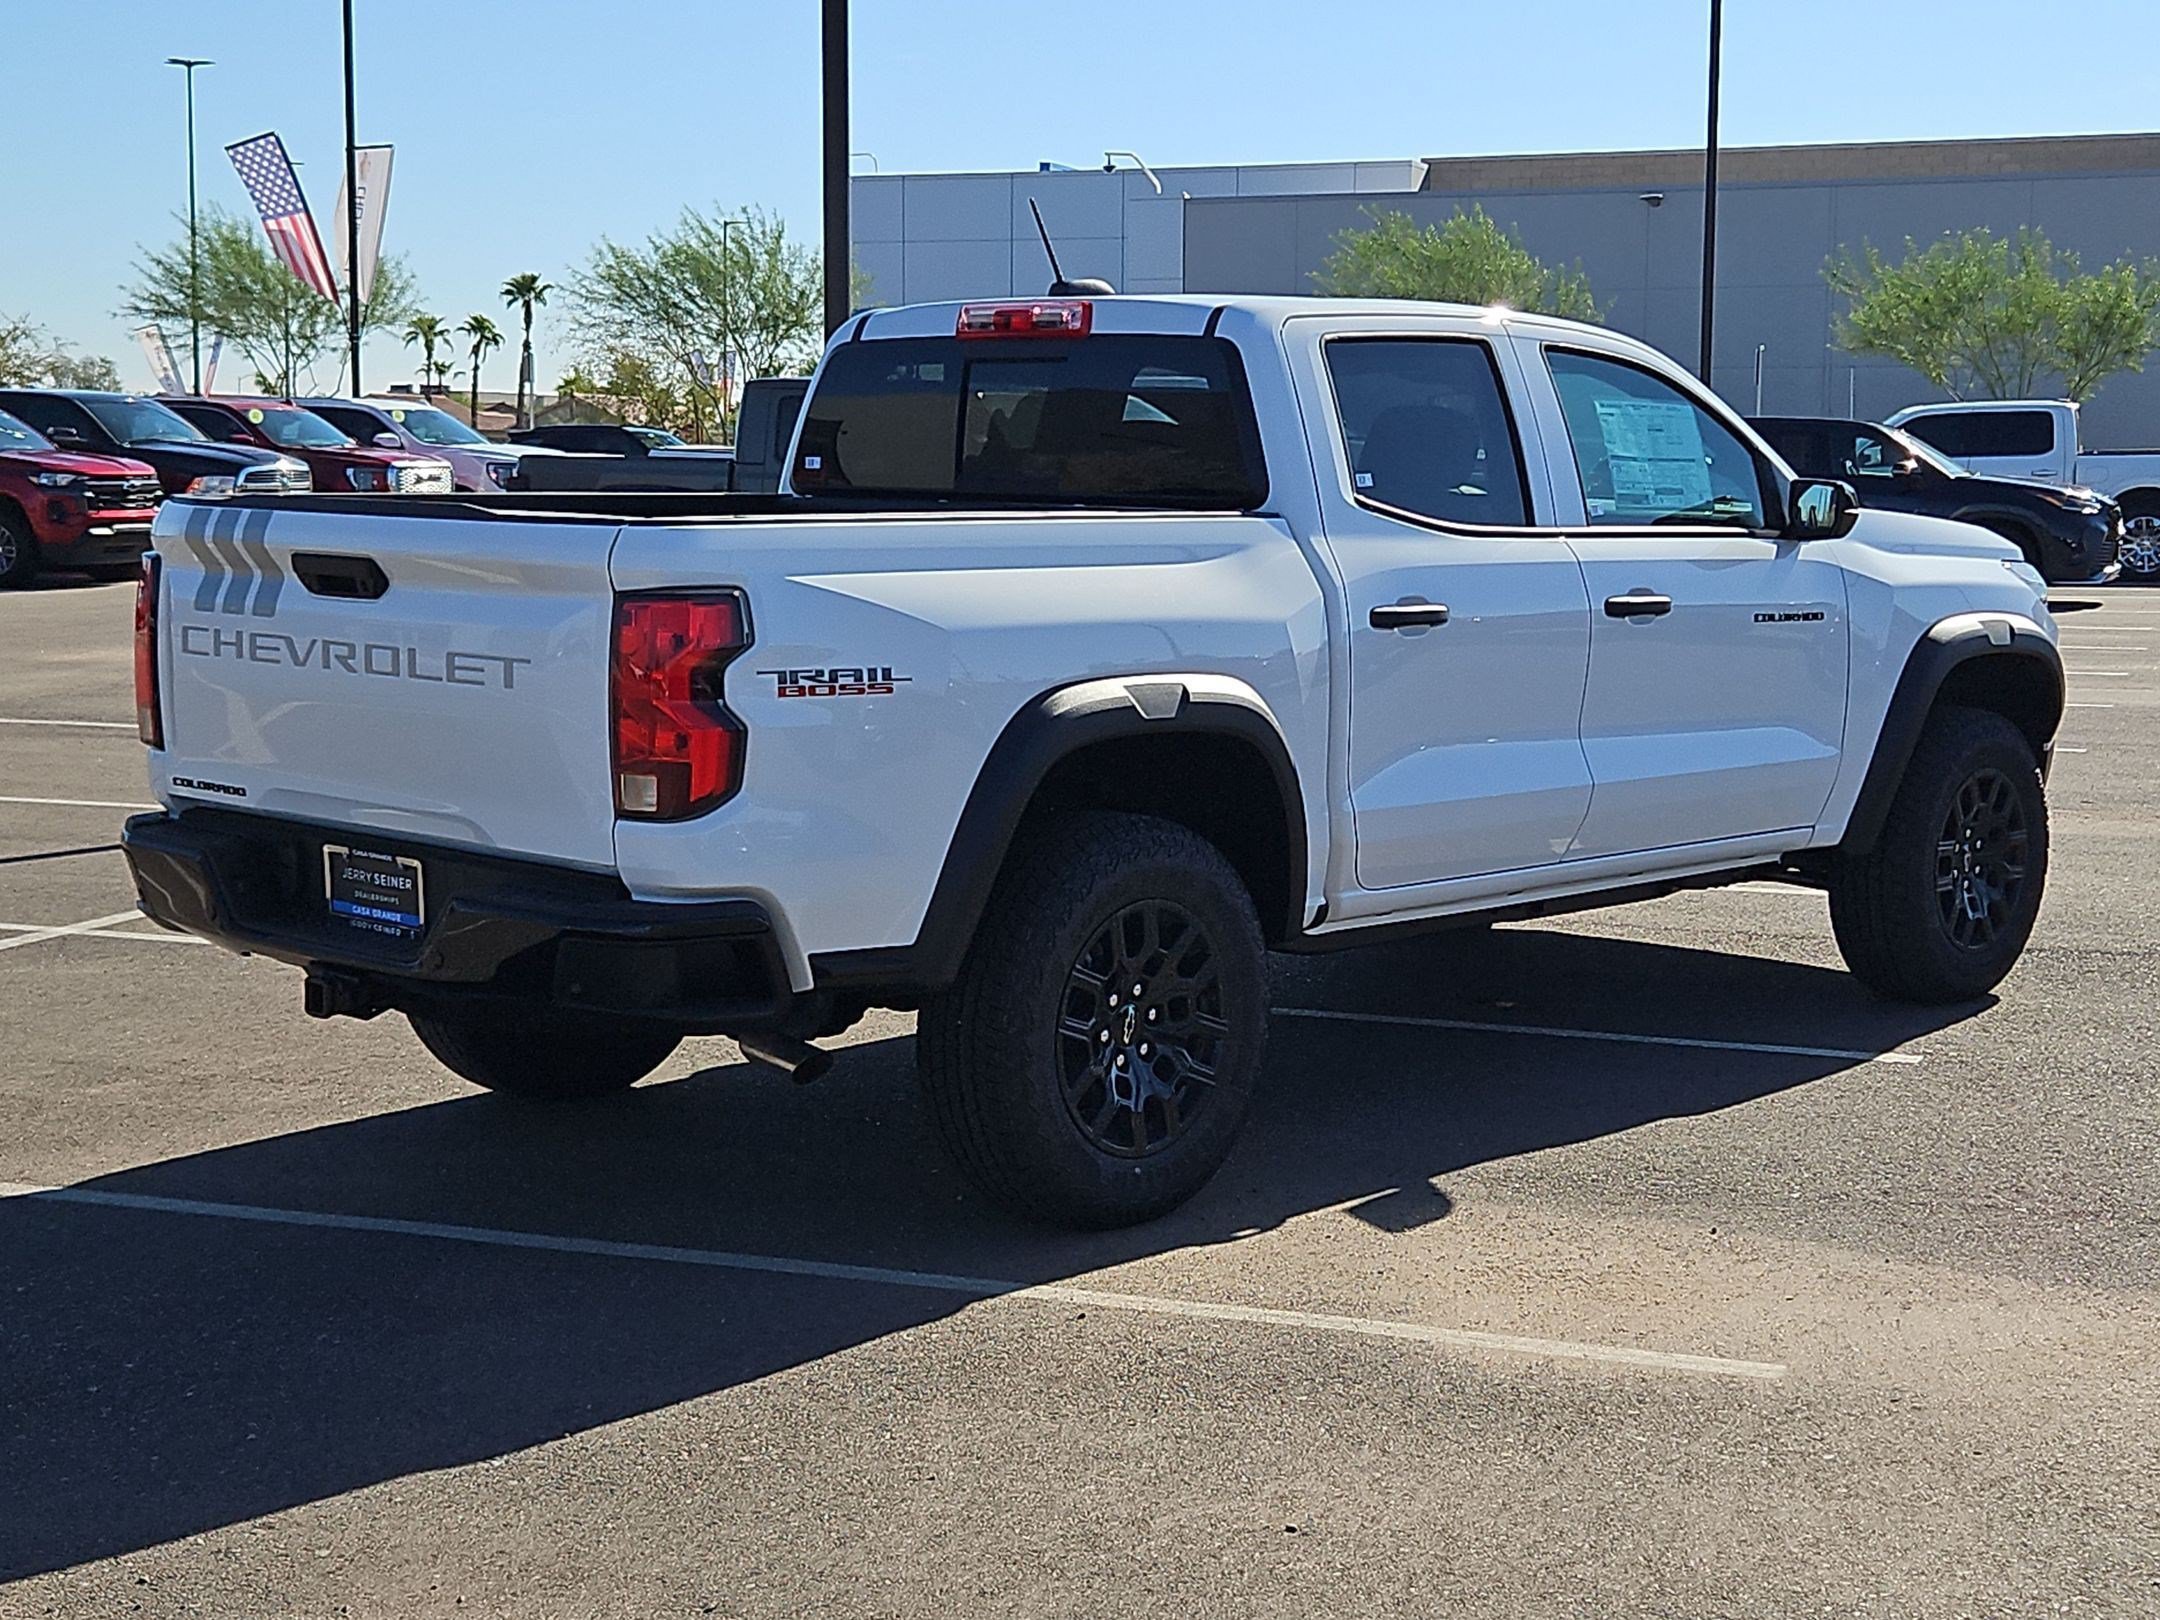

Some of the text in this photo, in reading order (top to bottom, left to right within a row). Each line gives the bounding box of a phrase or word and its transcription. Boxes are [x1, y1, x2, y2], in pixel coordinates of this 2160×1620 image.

[1753, 611, 1825, 623] COLORADO
[181, 625, 531, 689] CHEVROLET
[756, 667, 913, 685] TRAIL
[777, 682, 894, 698] BOSS
[171, 776, 247, 797] COLORADO
[342, 867, 412, 890] JERRY SEINER
[352, 905, 401, 923] CASA GRANDE
